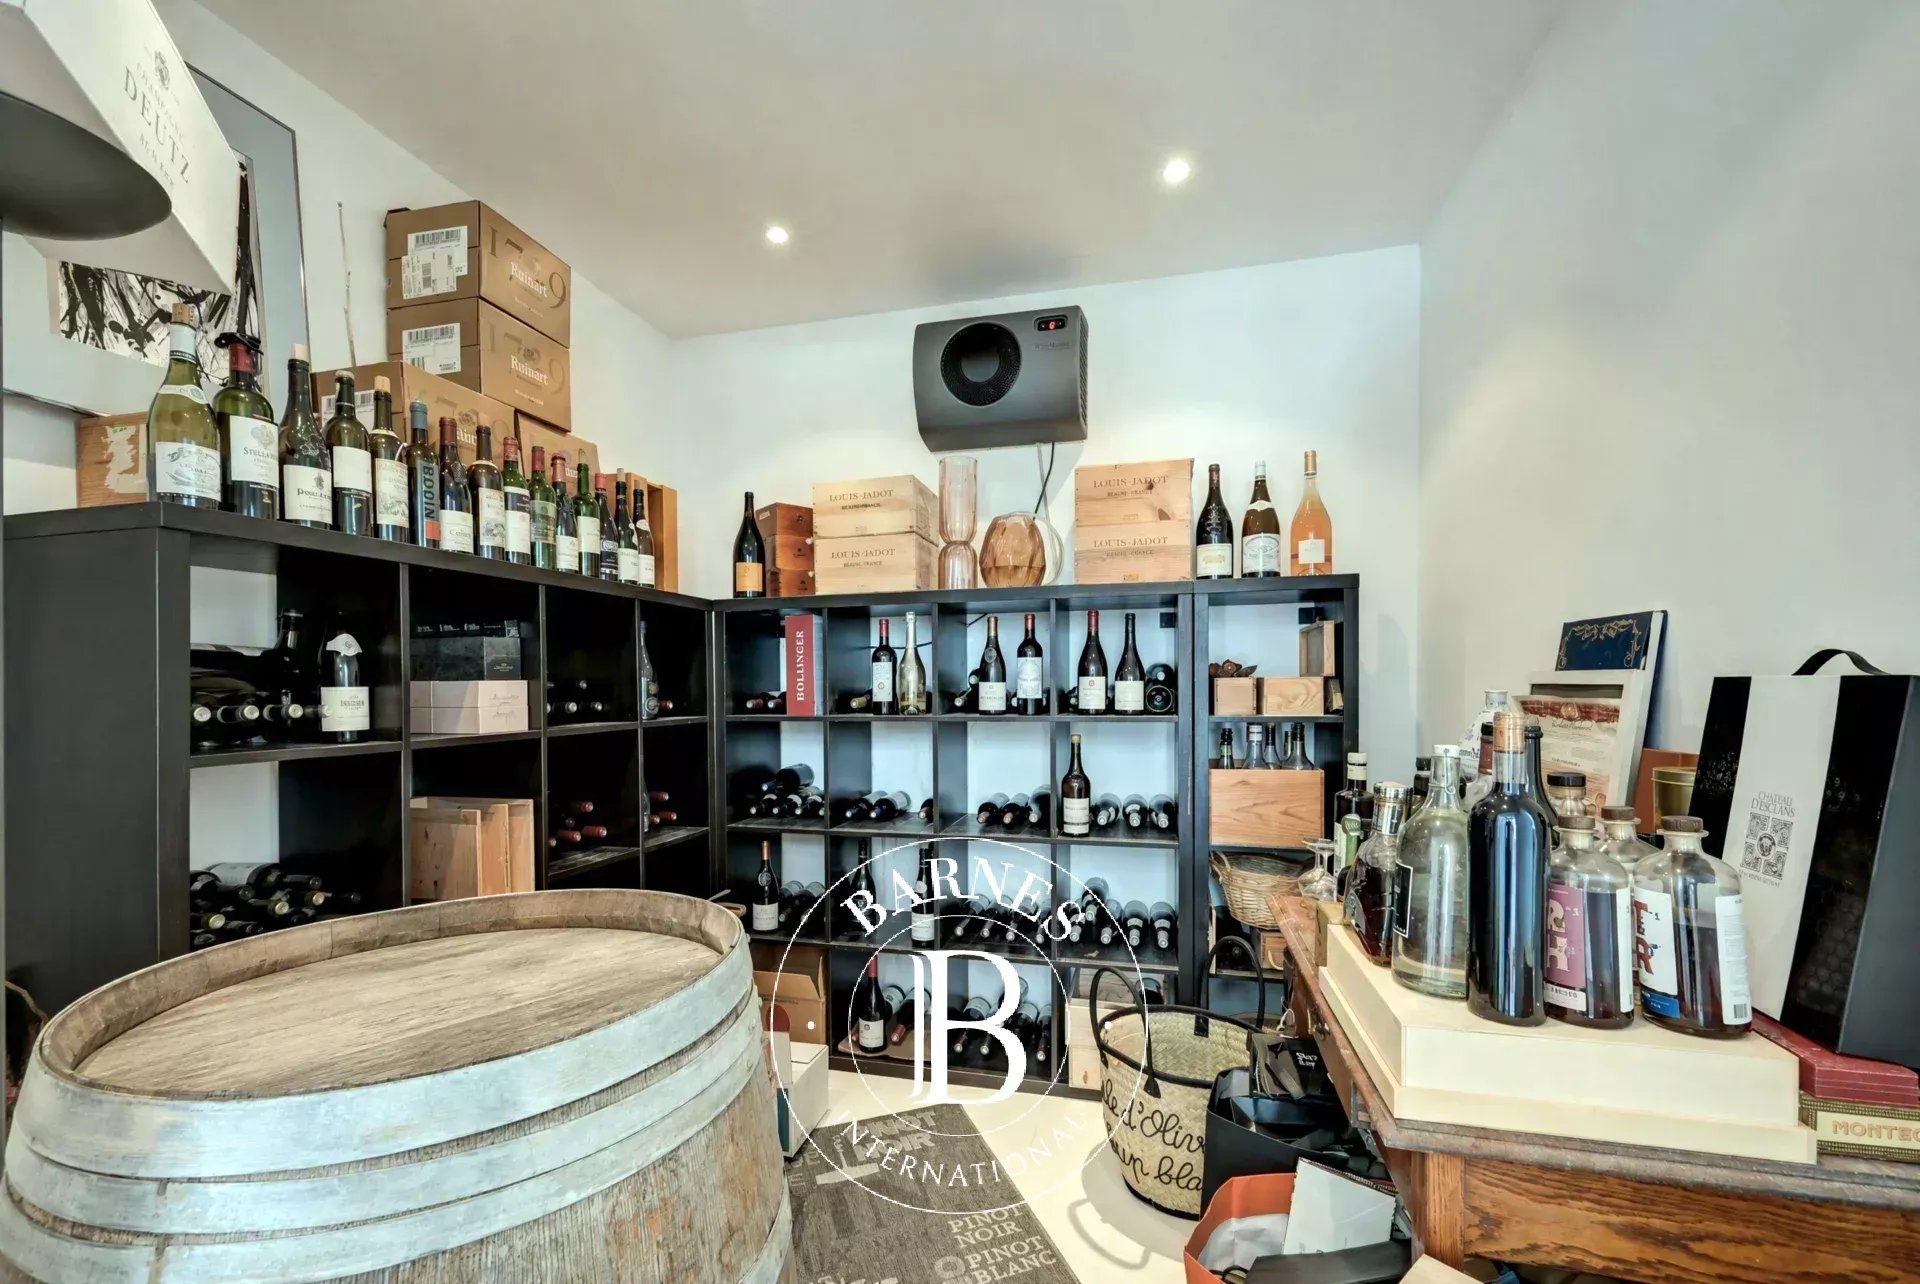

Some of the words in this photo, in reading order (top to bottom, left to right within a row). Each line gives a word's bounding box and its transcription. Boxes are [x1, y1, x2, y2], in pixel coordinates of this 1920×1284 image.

[125, 65, 189, 184] DEUTZ
[510, 261, 548, 298] Ruinart
[510, 354, 548, 385] Ruinart
[829, 493, 859, 502] LOUIS
[862, 489, 894, 500] JADOT
[1093, 478, 1127, 489] LOUIS
[1131, 475, 1169, 486] JADOT
[831, 549, 861, 559] LOUIS
[864, 548, 896, 558] JADOT
[1093, 538, 1127, 548] LOUIS
[1131, 536, 1169, 546] JADOT
[795, 630, 805, 702] BOLLINGER
[853, 1132, 936, 1162] NOIR
[947, 1204, 1024, 1234] PINOT
[953, 1220, 1023, 1249] NOIR
[964, 1235, 1044, 1270] PINOT
[971, 1249, 1057, 1284] BLANC
